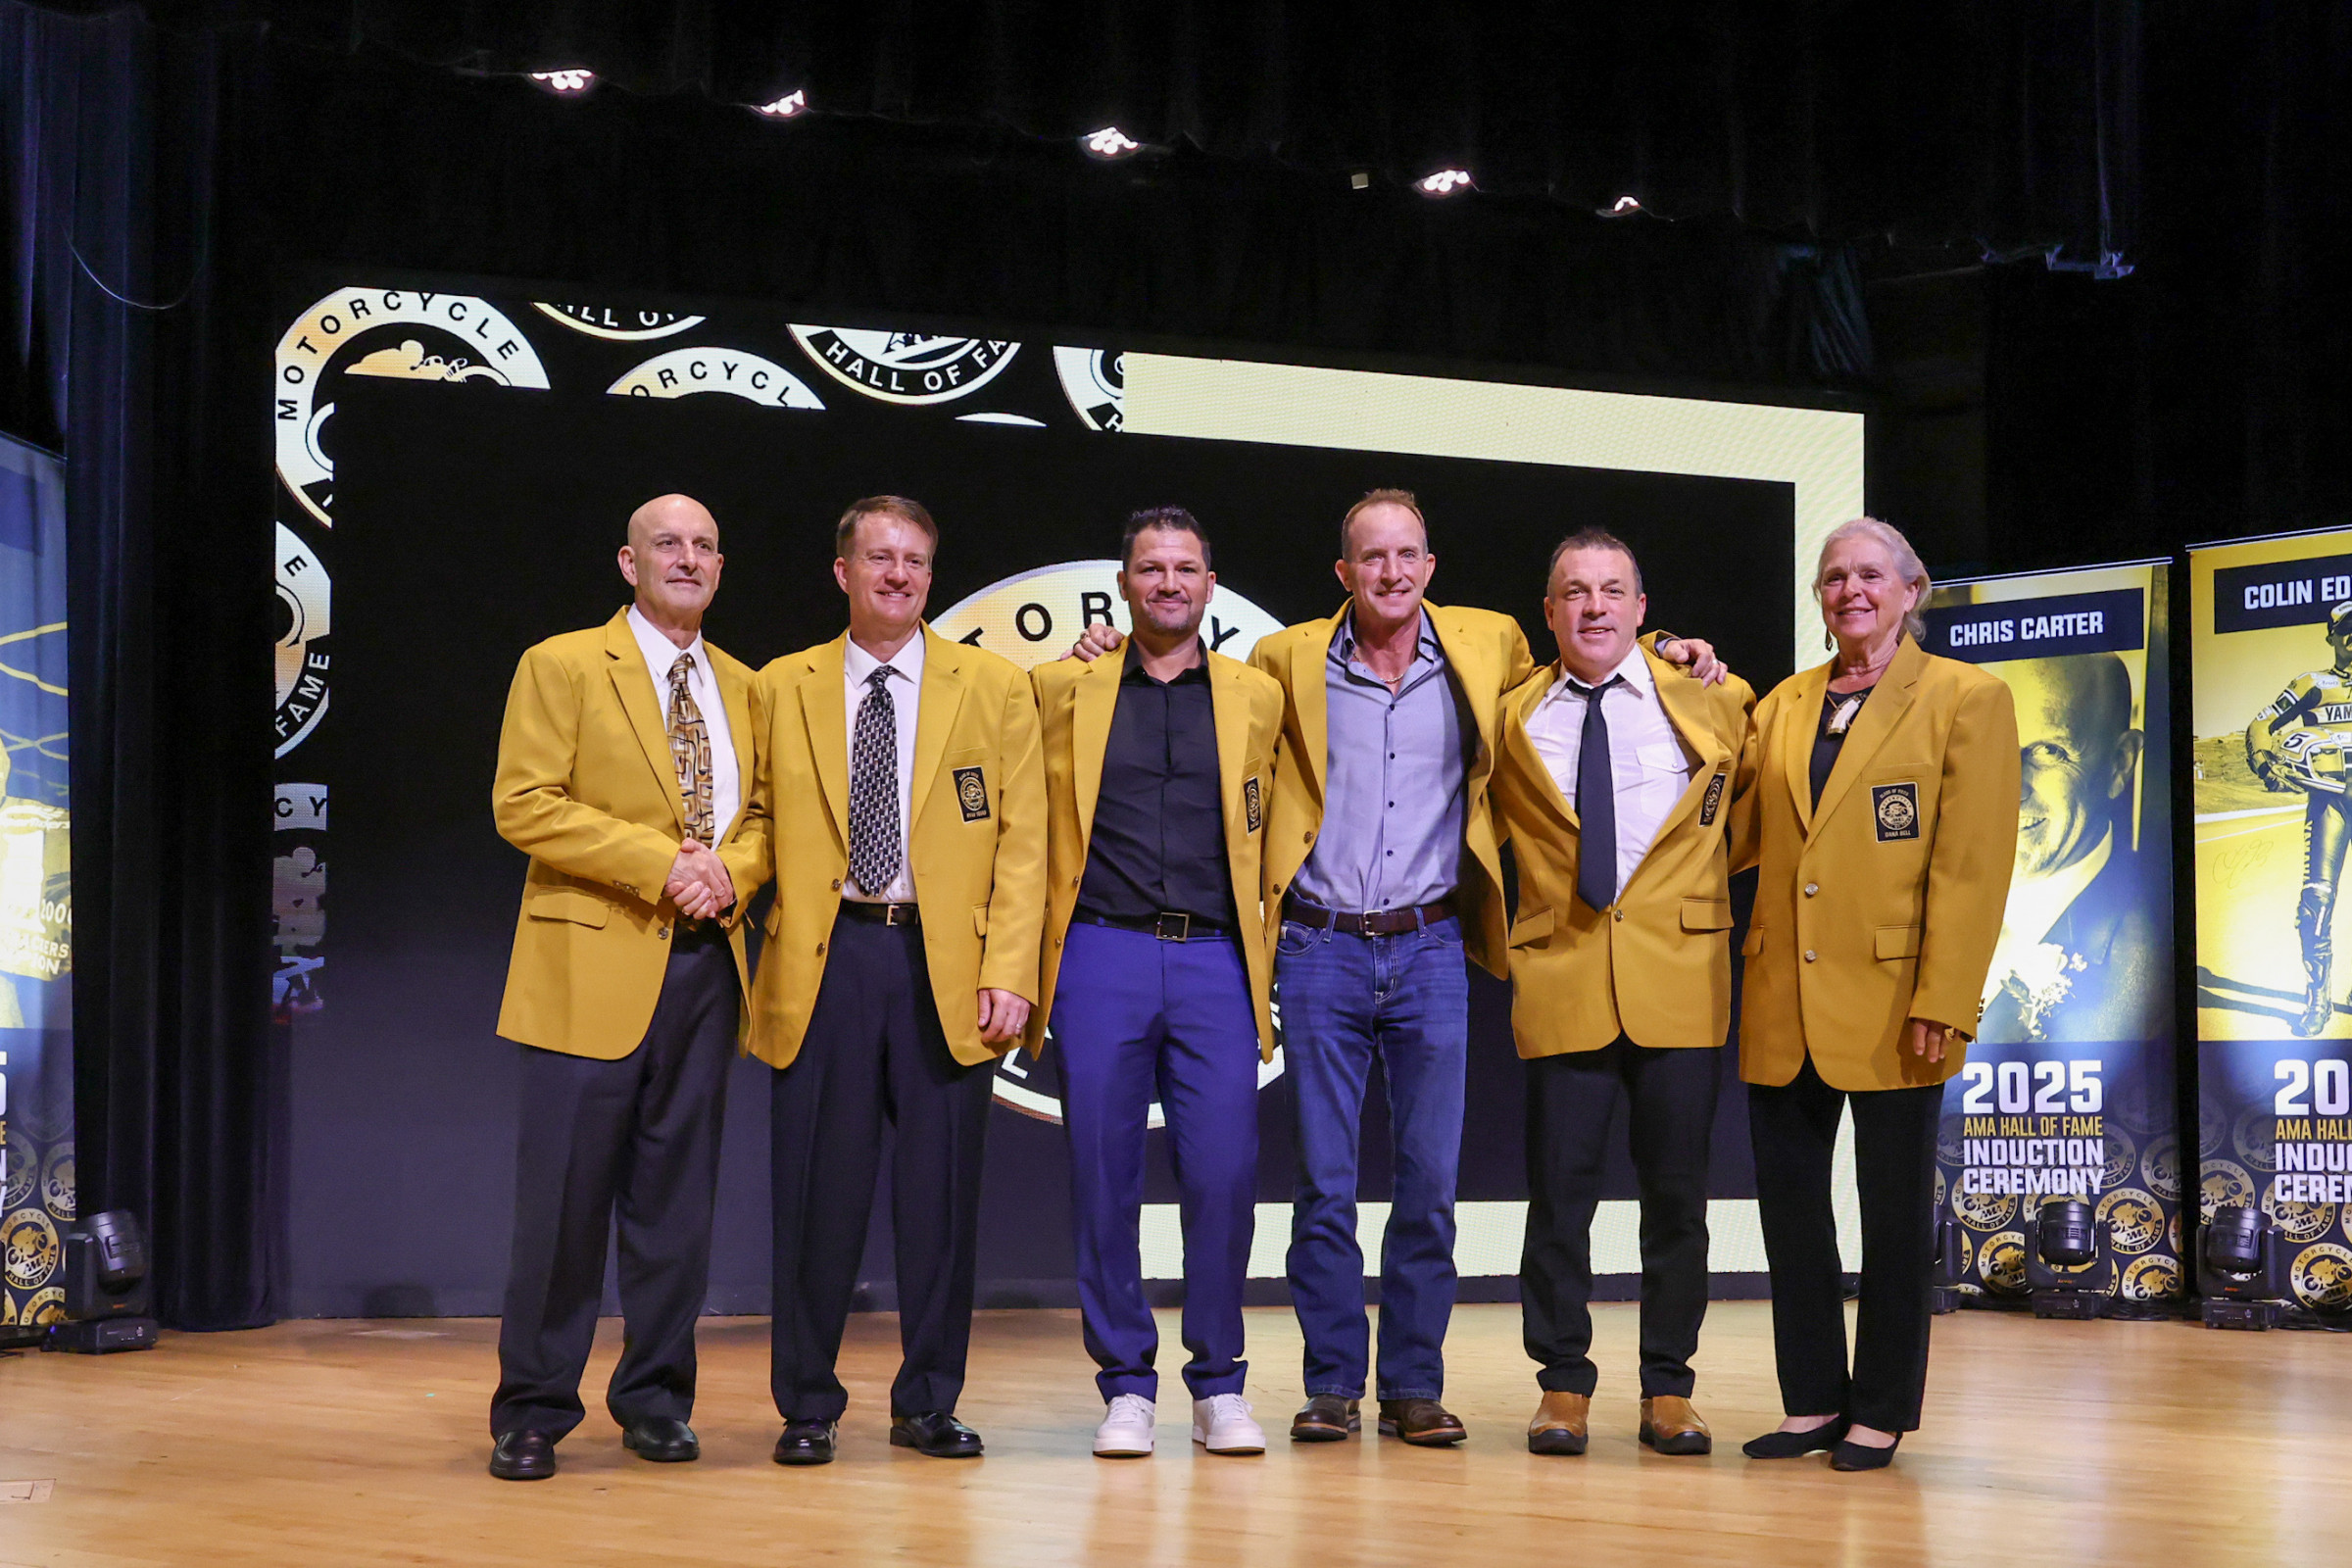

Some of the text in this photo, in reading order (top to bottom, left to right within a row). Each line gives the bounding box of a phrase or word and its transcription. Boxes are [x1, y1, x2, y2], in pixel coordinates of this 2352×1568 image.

[278, 292, 520, 420] MOTORCYCLE
[825, 340, 905, 392] HALL
[923, 364, 961, 391] OF
[2244, 579, 2313, 611] COLIN
[1950, 611, 2104, 647] CHRIS CARTER
[2325, 703, 2352, 722] YAM
[2283, 732, 2311, 749] 5
[1962, 1059, 2103, 1114] 2025
[2274, 1058, 2352, 1116] 20
[1963, 1115, 2104, 1137] AMA HALL OF FAME
[2275, 1118, 2312, 1140] AMA
[1963, 1138, 2105, 1166] INDUCTION
[1962, 1167, 2106, 1195] CEREMONY
